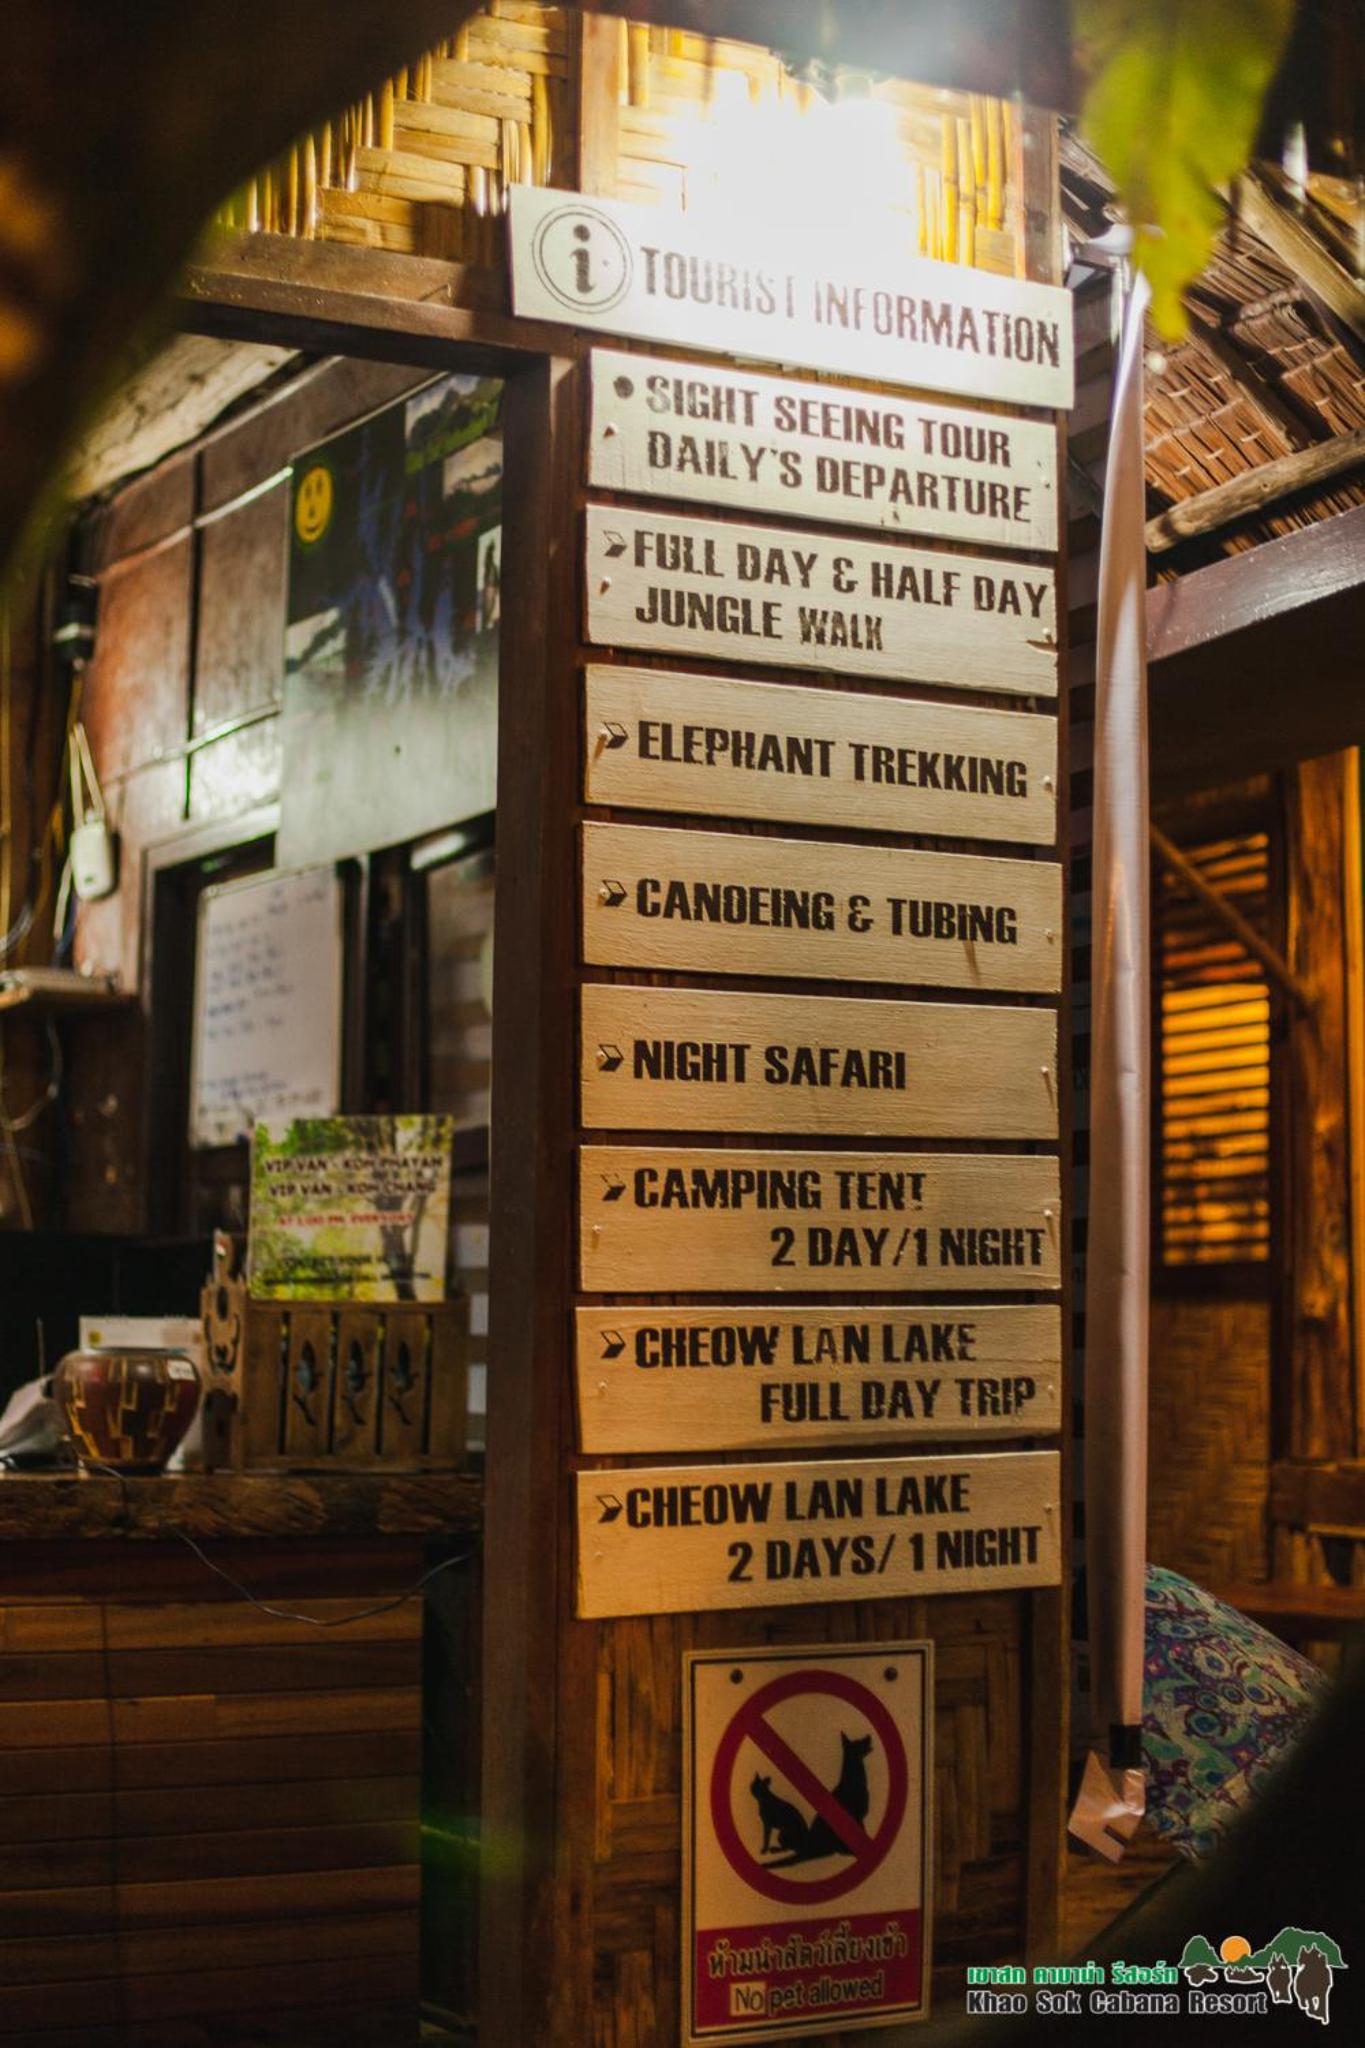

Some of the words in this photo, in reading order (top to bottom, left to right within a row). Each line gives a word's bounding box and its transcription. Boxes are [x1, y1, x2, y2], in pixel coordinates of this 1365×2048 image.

[641, 247, 795, 319] TOURIST
[814, 280, 1060, 367] INFORMATION
[646, 375, 760, 427] SIGHT
[774, 395, 905, 450] SEEING
[918, 418, 1011, 468] TOUR
[647, 431, 802, 489] DAILY'S
[816, 456, 1031, 524] DEPARTURE
[633, 530, 725, 579] FULL
[737, 542, 818, 589] DAY
[832, 557, 858, 594] &
[872, 560, 962, 606] HALF
[974, 573, 1049, 618] DAY
[636, 586, 782, 639] JUNGLE
[799, 605, 883, 652] WALK
[638, 720, 835, 778] ELEPHANT
[848, 742, 1027, 798] TREKKING
[636, 877, 835, 931] CANOEING
[848, 895, 873, 932] &
[887, 897, 1018, 945] TUBING
[633, 1039, 750, 1083] NIGHT
[764, 1045, 906, 1089] SAFARI
[633, 1167, 821, 1209] CAMPING
[835, 1171, 926, 1210] TENT
[771, 1227, 795, 1266] 2
[939, 1228, 1045, 1266] NIGHT
[635, 1327, 780, 1368] CHEOW
[792, 1324, 870, 1365] LAN
[883, 1323, 976, 1364] LAKE
[761, 1382, 850, 1422] FULL
[861, 1380, 941, 1419] DAY
[955, 1376, 1035, 1416] TRIP
[626, 1482, 772, 1528] CHEOW
[786, 1478, 862, 1520] LAN
[876, 1473, 971, 1516] LAKE
[728, 1541, 752, 1582] 2
[937, 1526, 1042, 1569] NIGHT
[735, 1986, 764, 2012] No
[769, 1981, 805, 2016] pet
[808, 1970, 882, 2005] allowed
